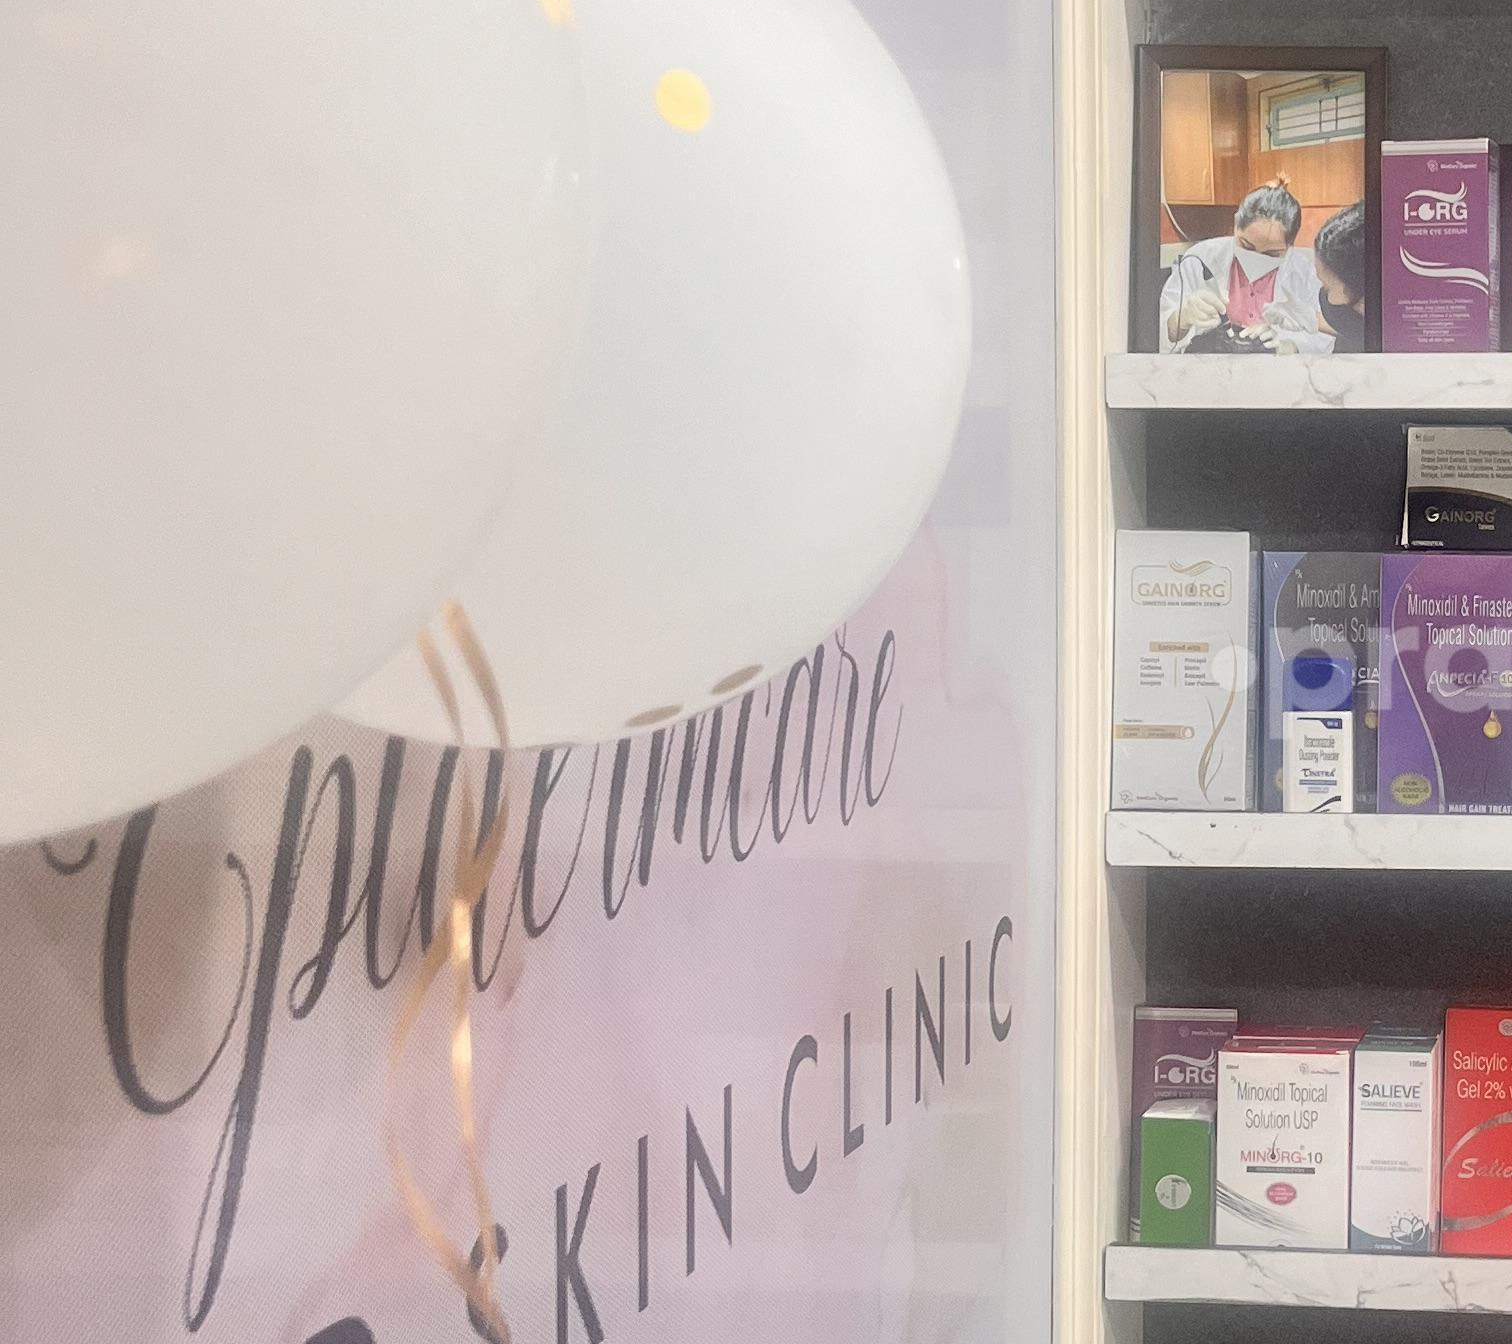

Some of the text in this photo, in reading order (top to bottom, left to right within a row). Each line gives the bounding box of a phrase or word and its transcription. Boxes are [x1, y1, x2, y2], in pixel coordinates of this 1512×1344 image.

[1404, 202, 1468, 221] I-ORG
[1425, 506, 1495, 524] GAINORG
[1137, 582, 1225, 599] GAINORG
[1297, 584, 1346, 608] Minoxidil
[1349, 584, 1359, 608] &
[1408, 593, 1457, 617] Minoxidil
[1461, 595, 1469, 617] &
[1308, 617, 1348, 647] Topical
[1426, 623, 1465, 649] Topical
[1448, 803, 1467, 813] HAIR
[1469, 804, 1487, 814] GAIN
[781, 915, 1015, 1196] CLINIC
[1453, 1050, 1508, 1075] Salicylic
[1237, 1081, 1328, 1105] Minoxidil Topical
[1360, 1083, 1421, 1099] SALIEVE
[1457, 1078, 1481, 1099] Gel
[1484, 1081, 1506, 1100] 2%
[1245, 1109, 1319, 1130] Solution USP
